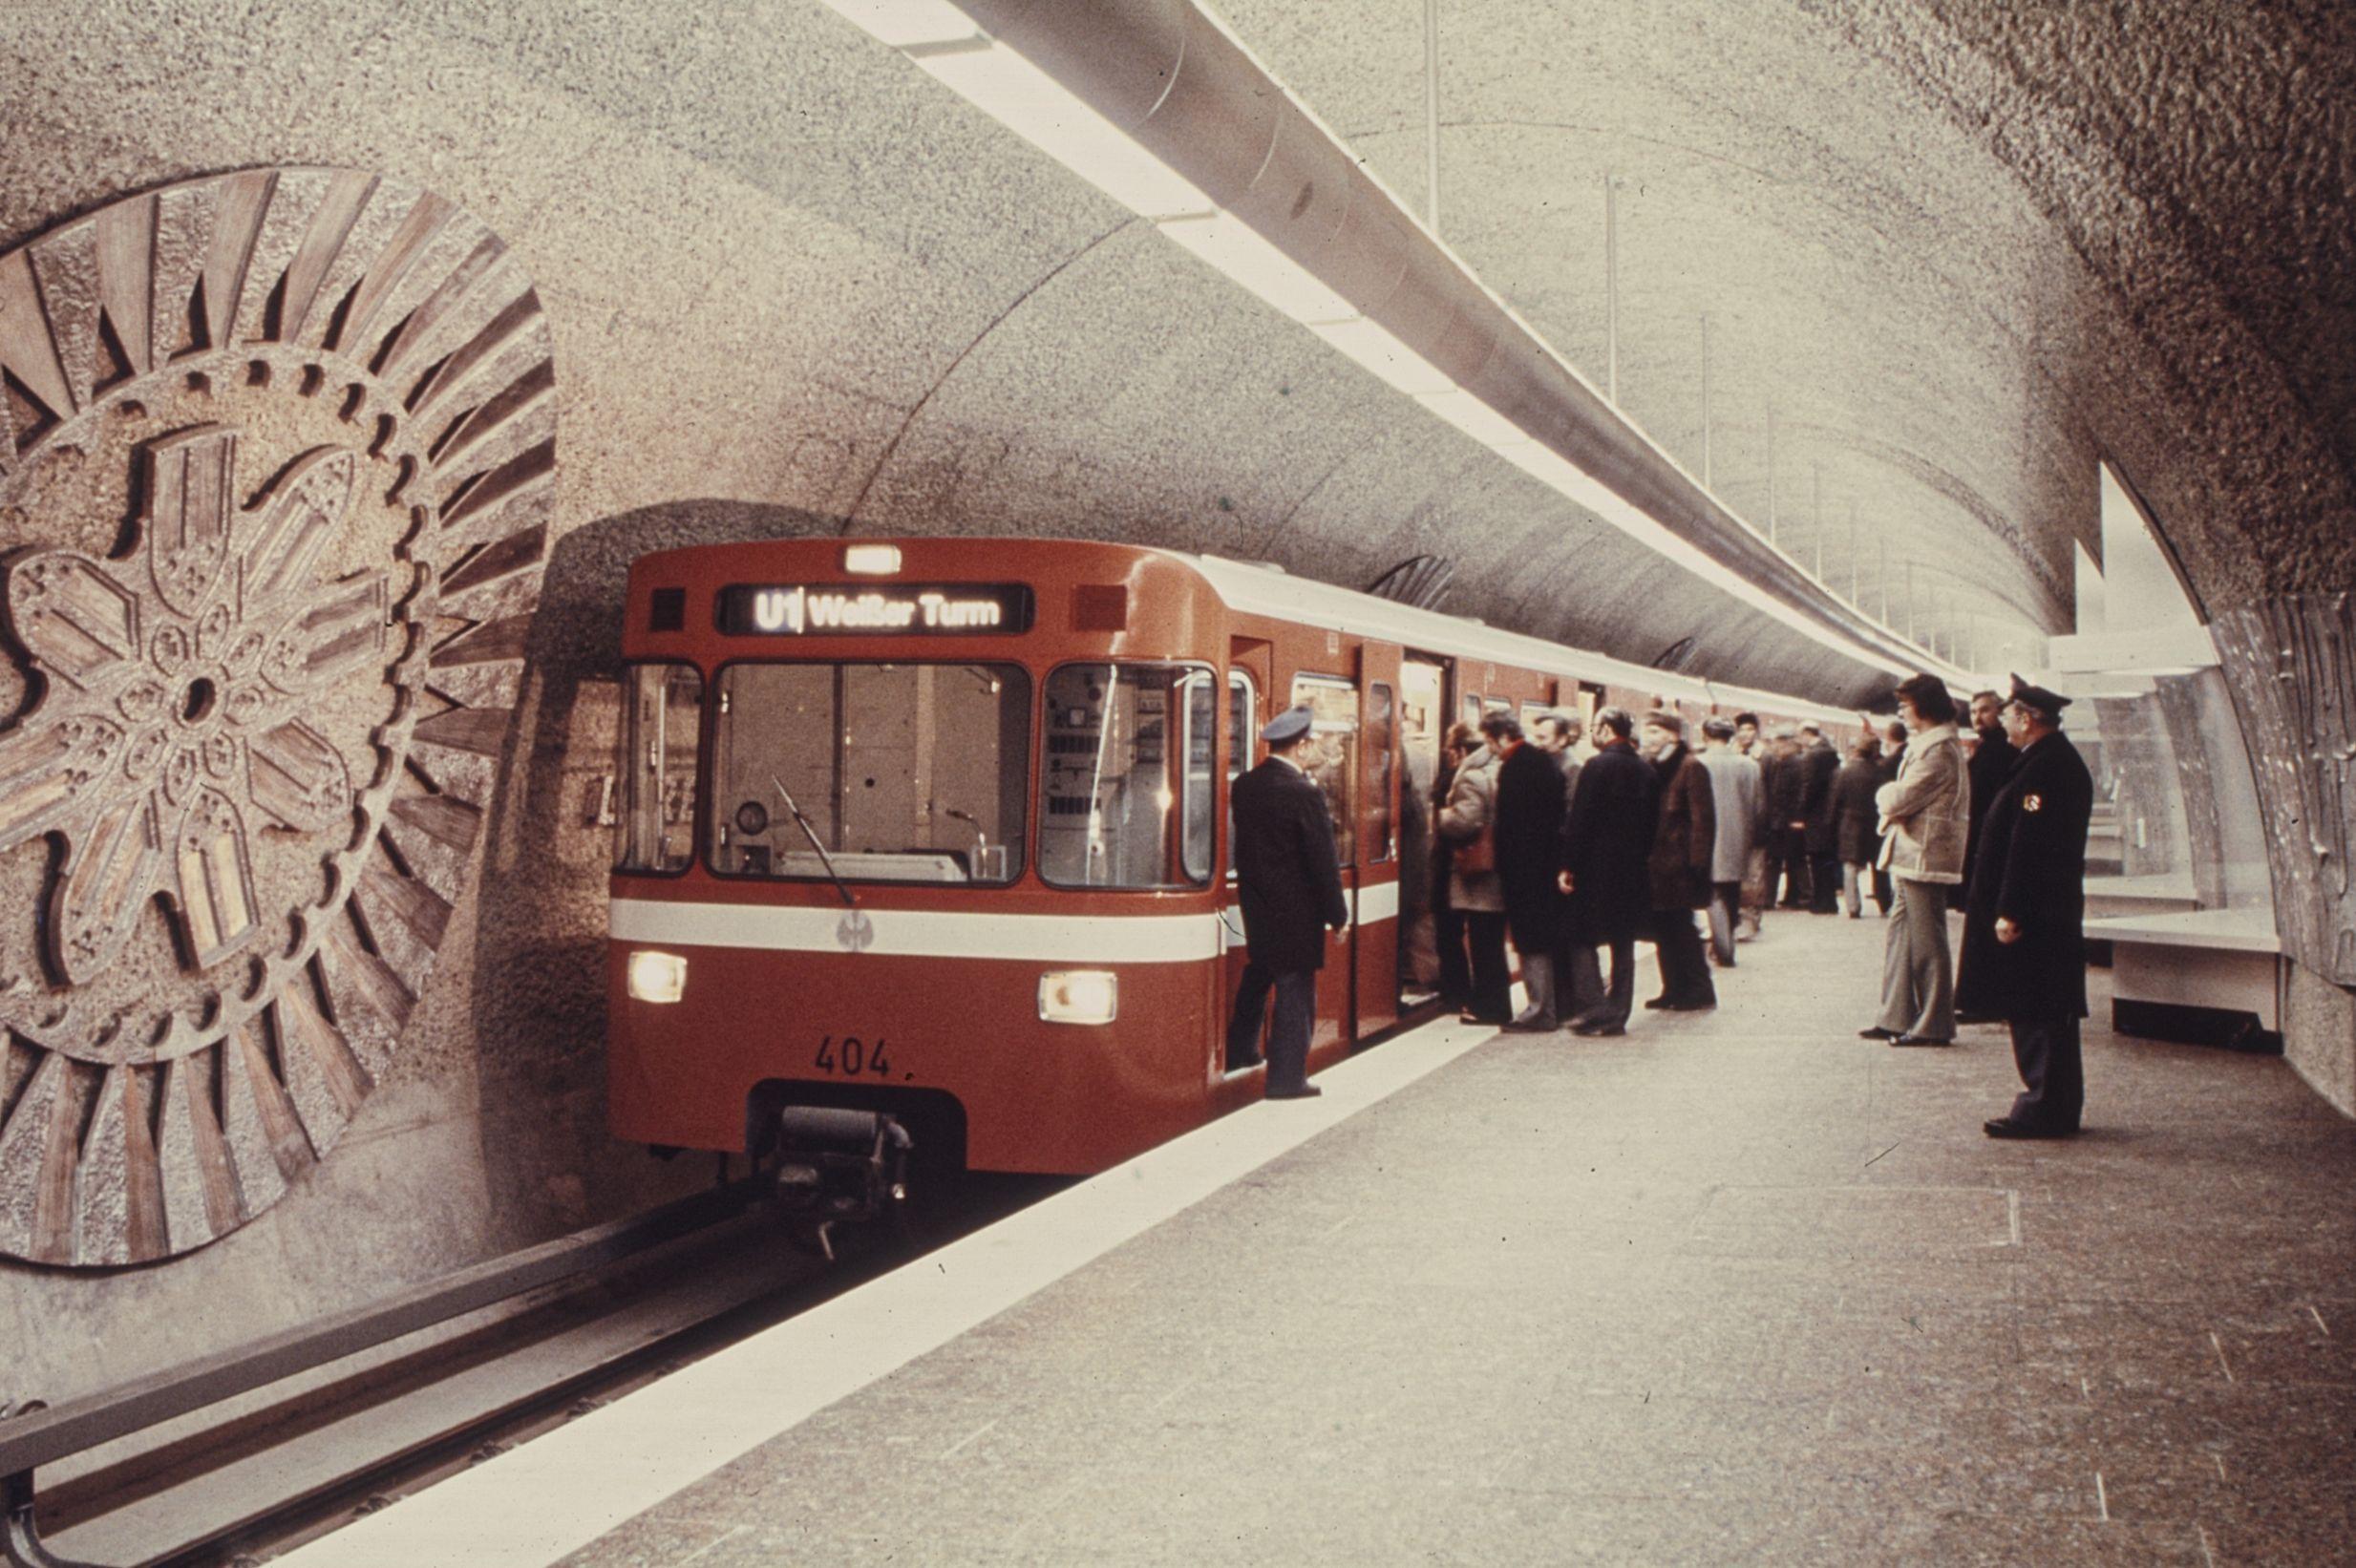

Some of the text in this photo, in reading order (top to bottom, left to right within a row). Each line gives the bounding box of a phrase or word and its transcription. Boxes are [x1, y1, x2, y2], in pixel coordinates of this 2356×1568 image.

[755, 592, 798, 630] U1
[919, 593, 1001, 627] Turm
[815, 1034, 890, 1076] 404
